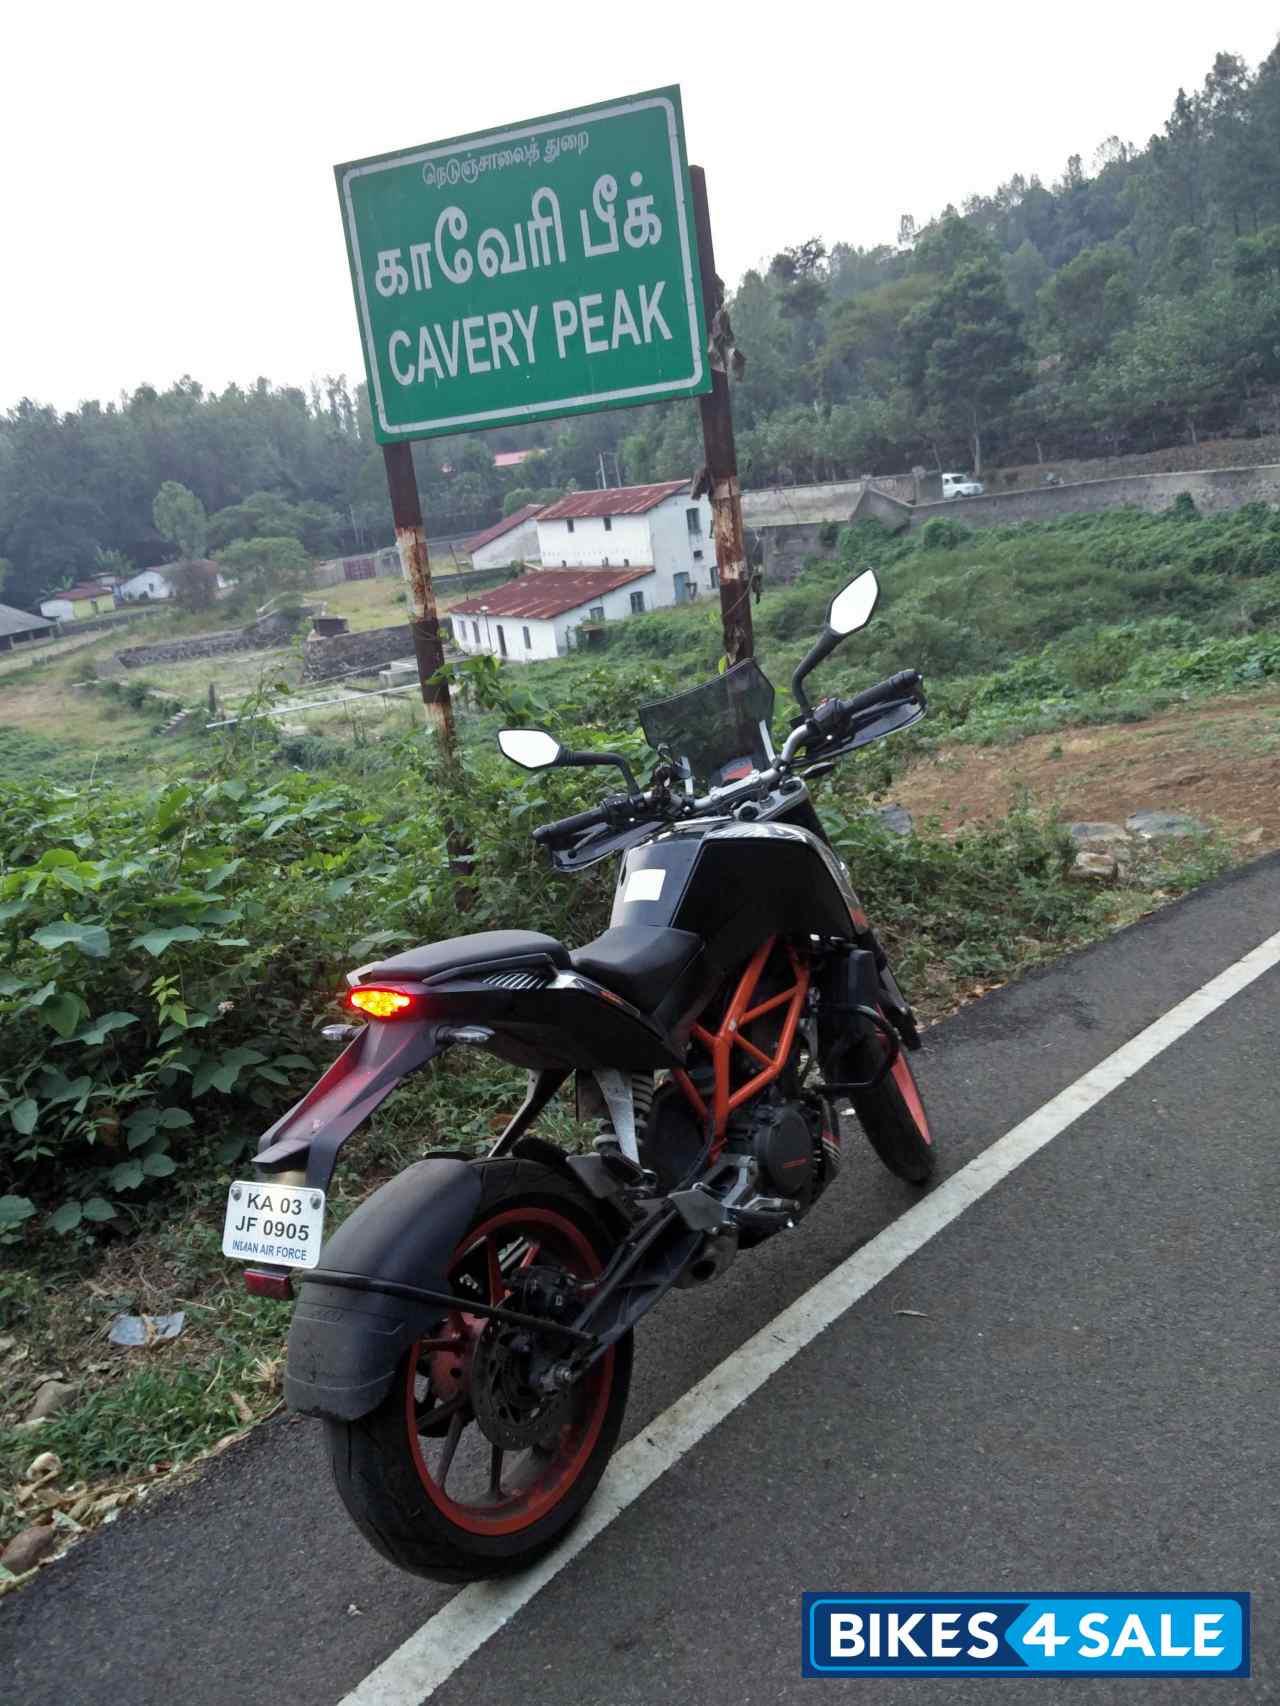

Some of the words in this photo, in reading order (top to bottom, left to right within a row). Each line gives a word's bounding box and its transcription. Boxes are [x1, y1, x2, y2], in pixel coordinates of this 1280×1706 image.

[374, 186, 567, 298] காவேரி
[580, 171, 663, 258] பீக்
[388, 305, 539, 386] CAVERY
[553, 281, 673, 359] PEAK
[247, 1193, 273, 1212] KA
[280, 1198, 302, 1215] 03
[235, 1216, 258, 1232] JF
[263, 1220, 310, 1241] 0905
[260, 1245, 274, 1256] AIR
[276, 1246, 307, 1261] FORCE
